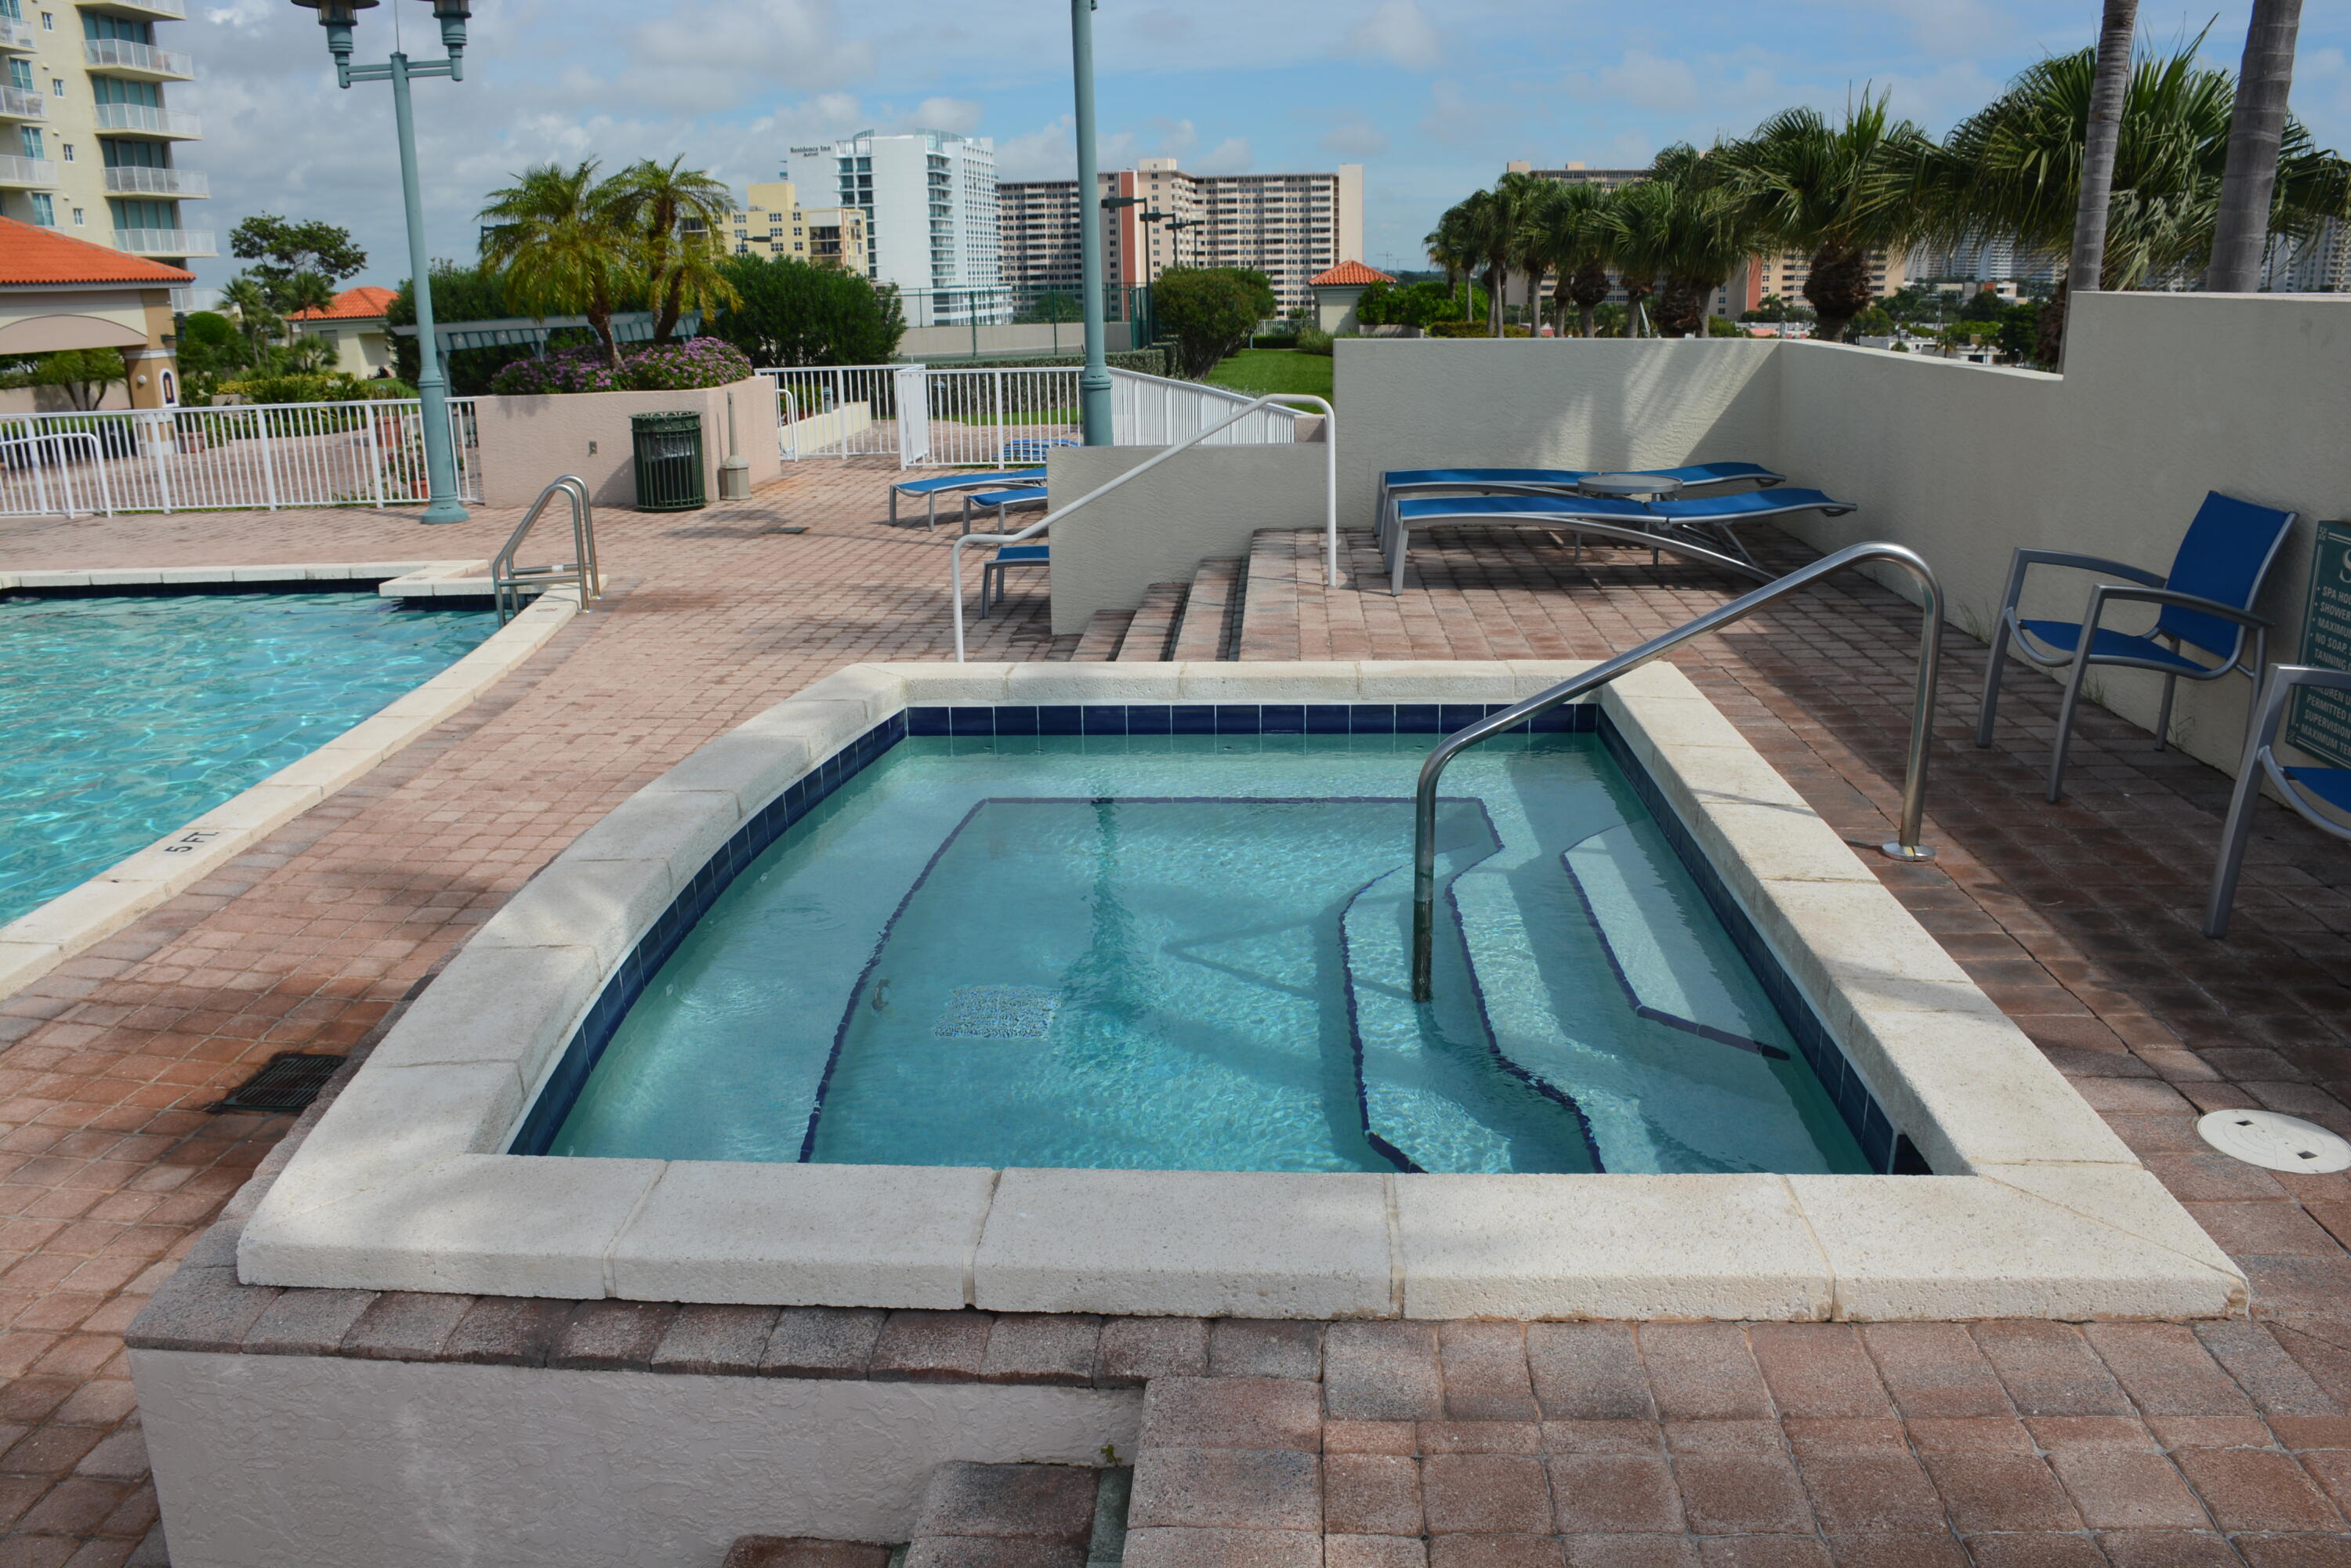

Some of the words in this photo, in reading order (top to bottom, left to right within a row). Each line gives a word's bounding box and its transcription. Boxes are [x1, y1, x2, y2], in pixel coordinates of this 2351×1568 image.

[2322, 585, 2337, 599] SPA
[2315, 632, 2326, 645] NO
[2315, 648, 2346, 670] TANNING
[2309, 686, 2345, 702] ILDREN
[2306, 693, 2347, 720] PERMITTED
[2304, 708, 2351, 740] SUPERVISION
[2300, 723, 2338, 750] MAXIMUM
